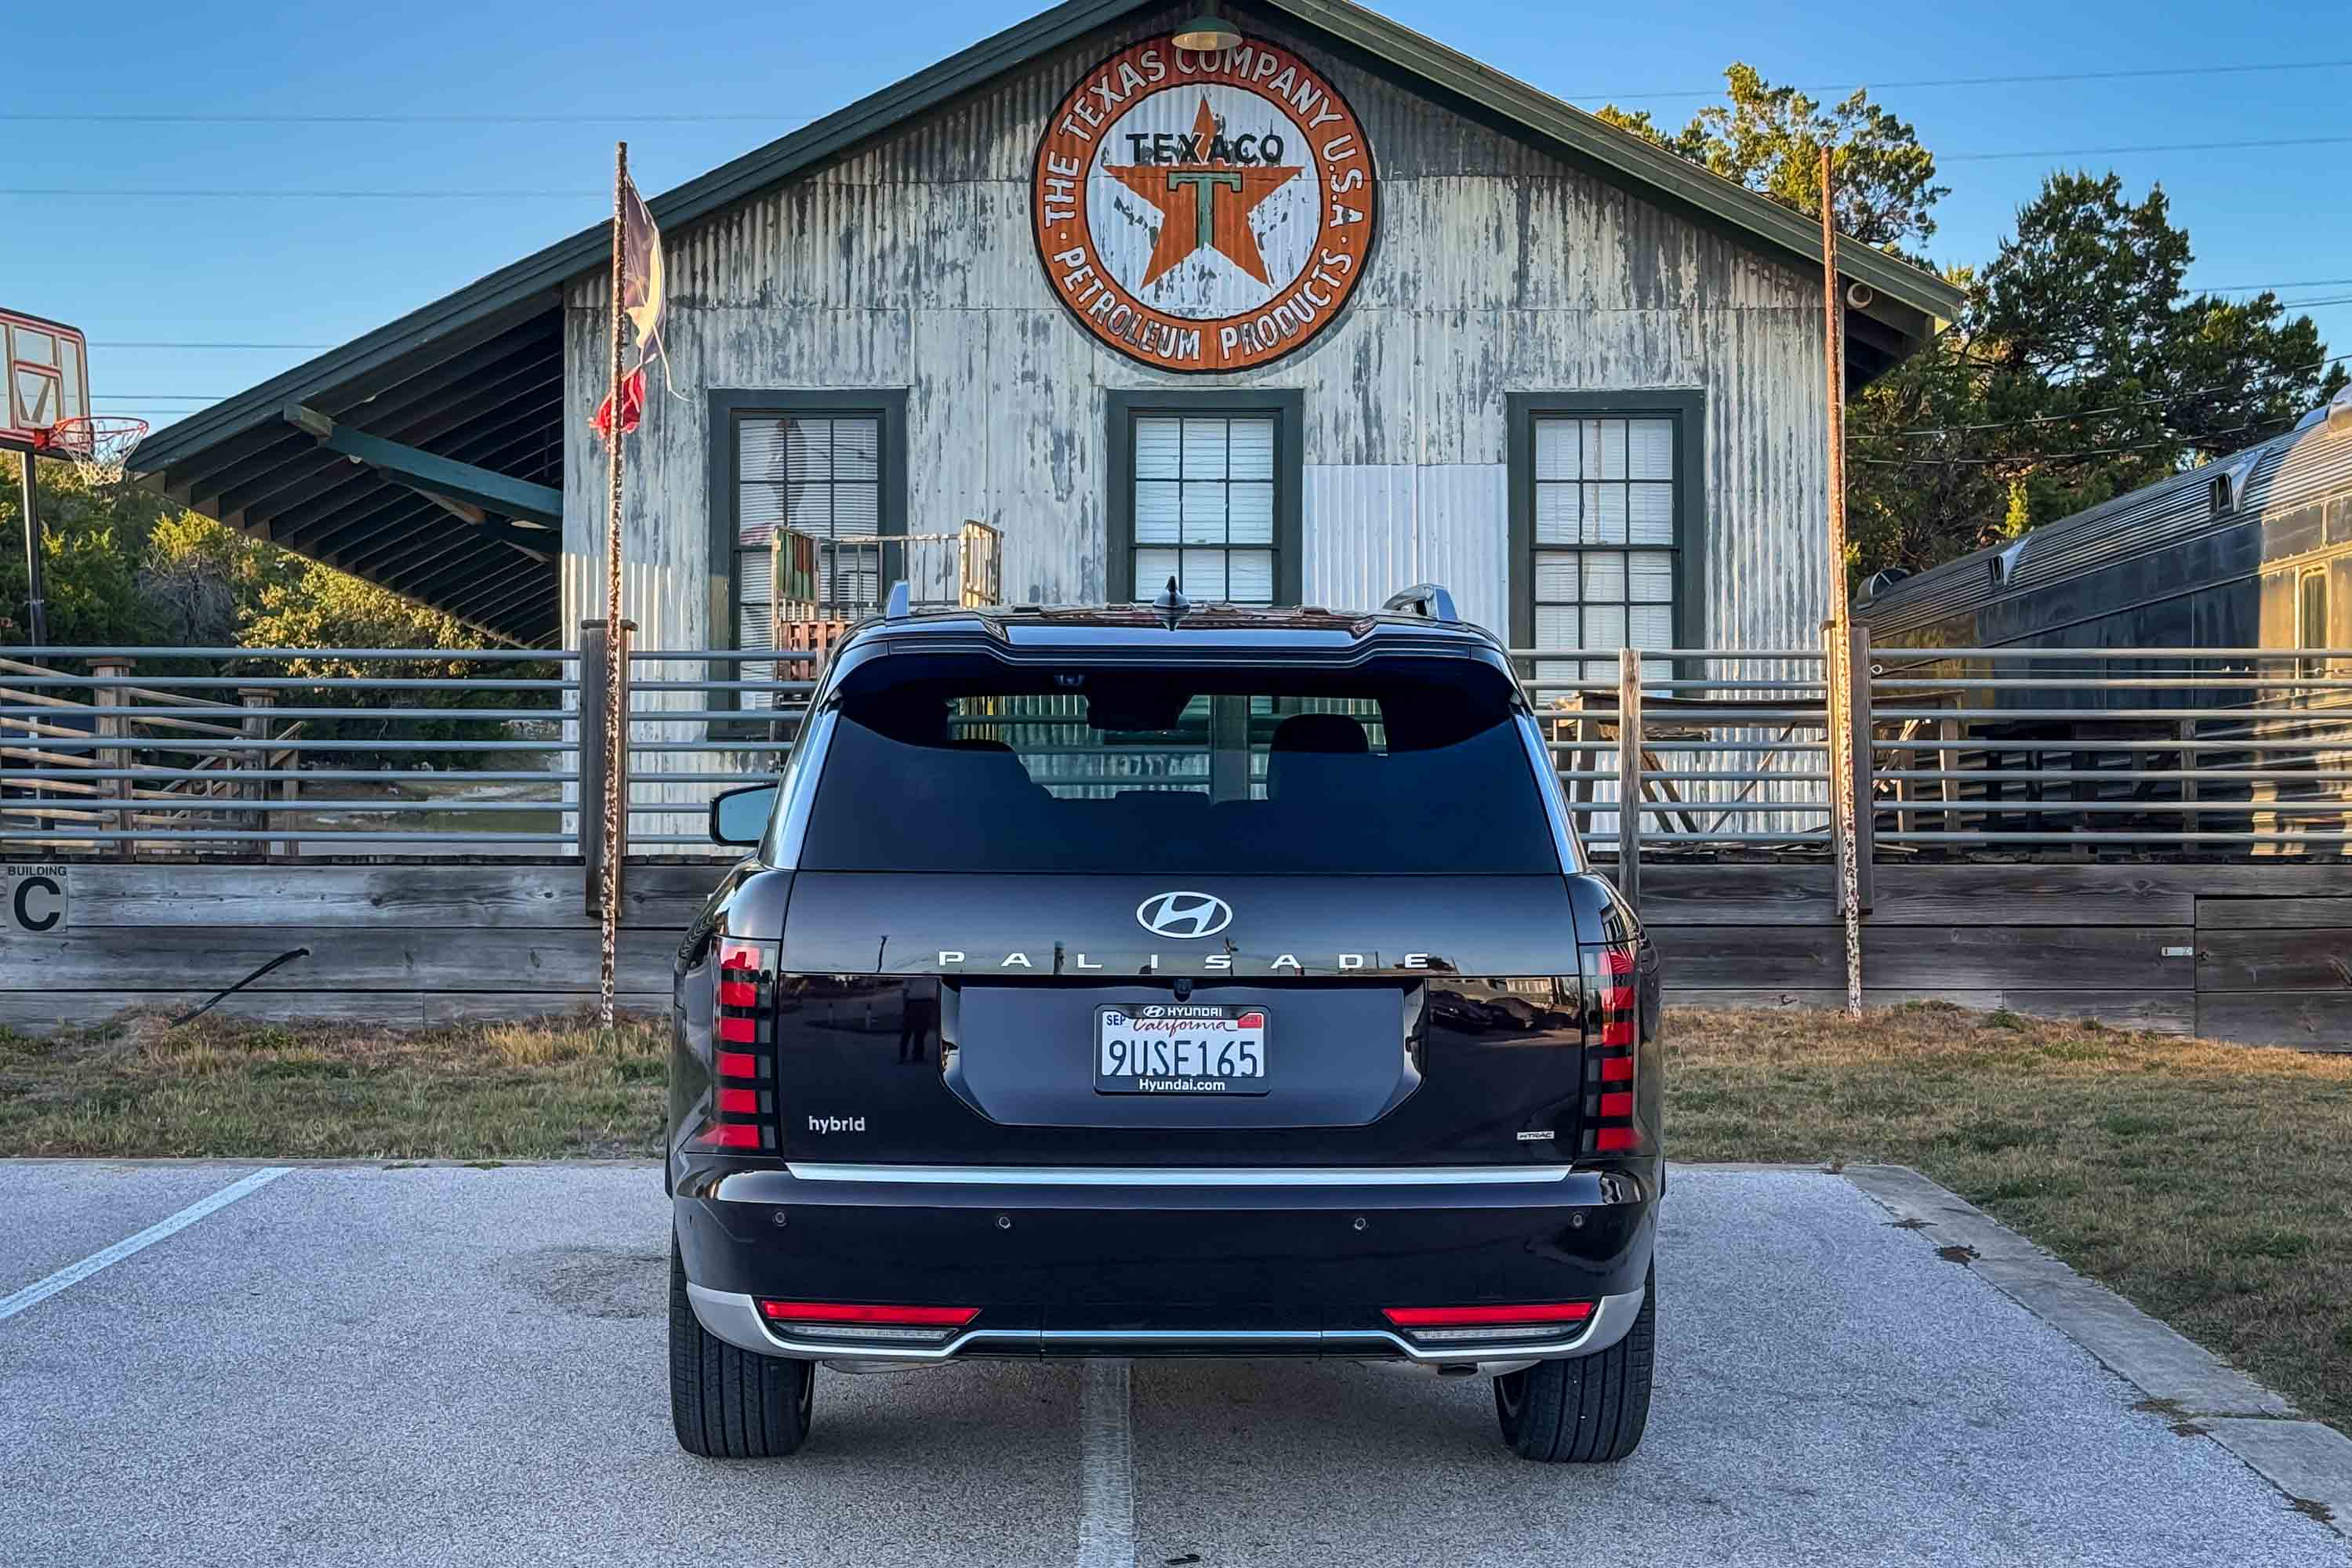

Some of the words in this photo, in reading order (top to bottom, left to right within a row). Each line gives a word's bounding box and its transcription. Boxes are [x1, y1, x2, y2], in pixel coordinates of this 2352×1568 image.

[1058, 50, 1167, 141] TEXAS
[1174, 46, 1343, 130] COMPANY
[1126, 132, 1284, 163] TEXACO
[1044, 151, 1080, 228] THE
[1167, 170, 1243, 247] T
[1054, 245, 1200, 361] PETROLEUM
[1220, 248, 1353, 360] PRODUCTS
[8, 866, 67, 876] BUILDING
[14, 877, 60, 931] C
[938, 950, 1429, 971] PALISADE
[1106, 1014, 1127, 1025] SEP
[1133, 1018, 1239, 1037] California
[1167, 1007, 1223, 1017] HYUNDAI
[1109, 1040, 1258, 1076] 9USE165
[1139, 1078, 1225, 1091] Hyundai.com
[809, 1115, 866, 1134] hybrid
